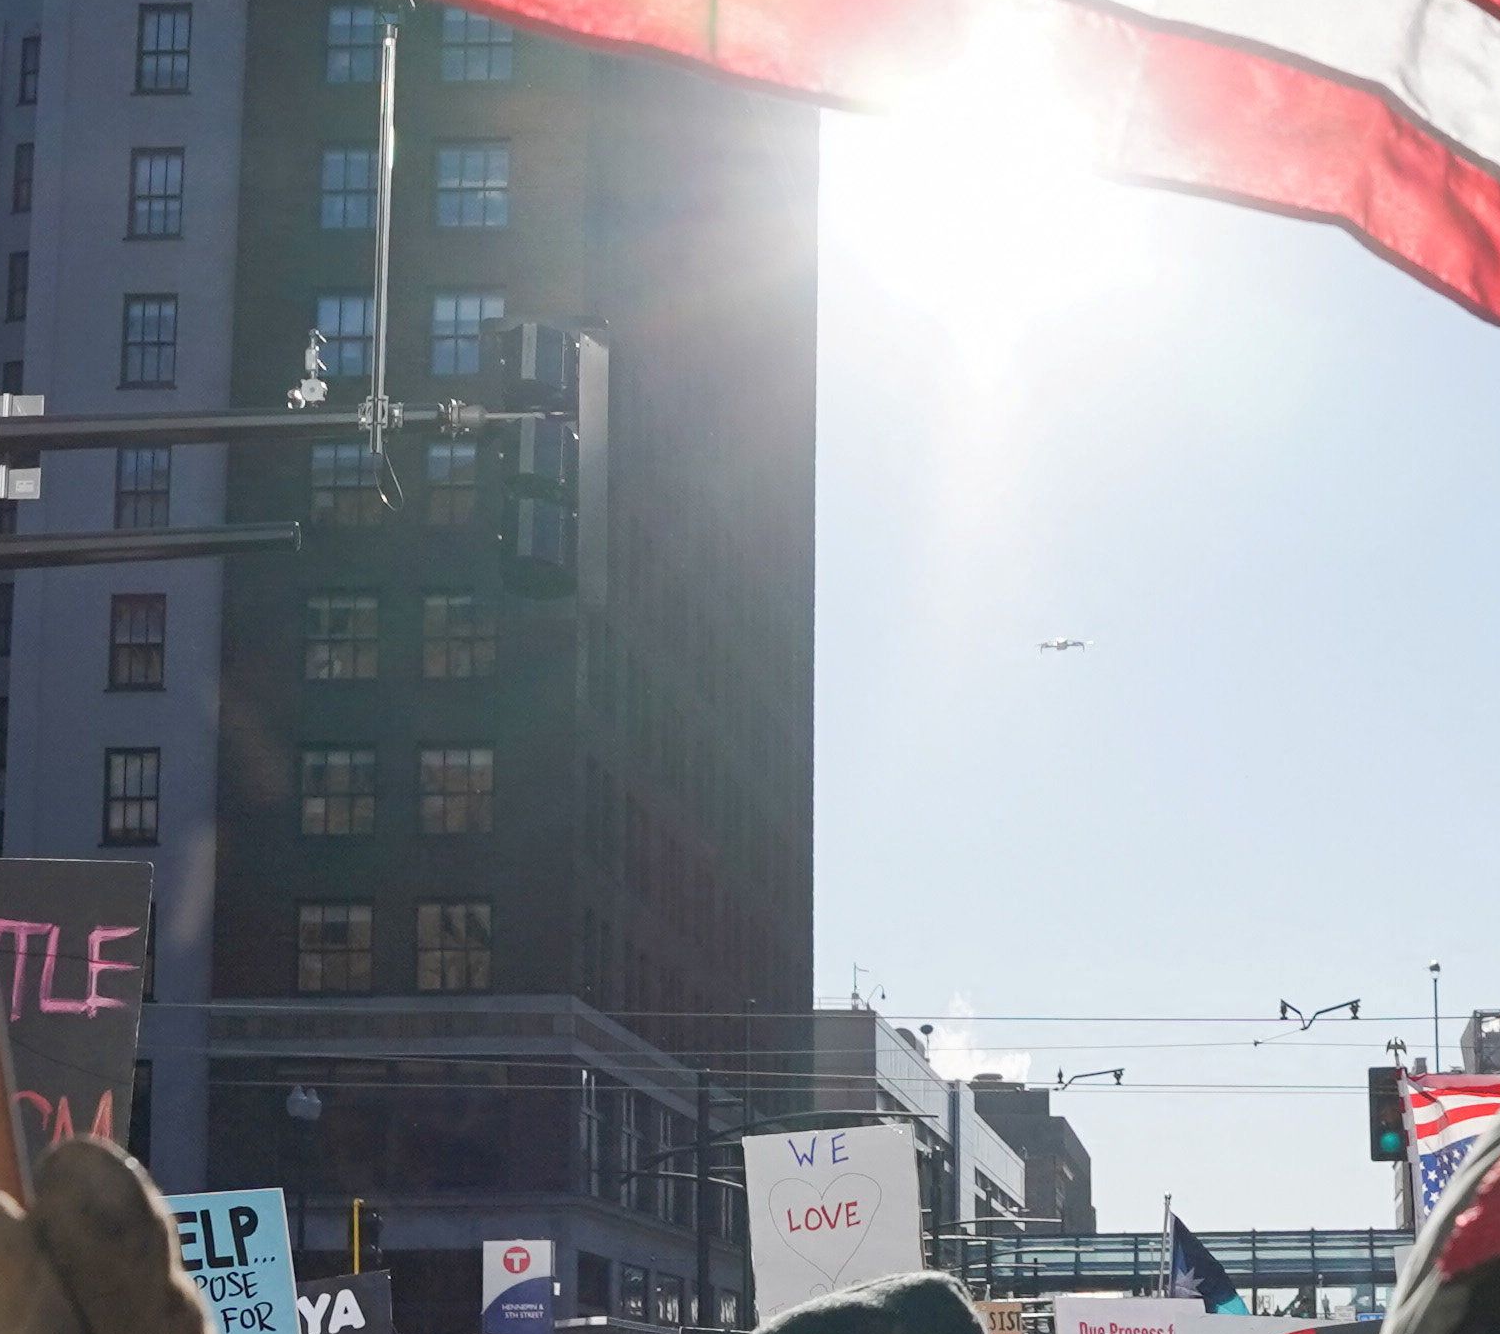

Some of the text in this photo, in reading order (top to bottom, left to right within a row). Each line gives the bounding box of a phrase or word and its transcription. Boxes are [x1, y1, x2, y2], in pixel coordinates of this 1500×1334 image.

[787, 1133, 849, 1167] WE
[787, 1201, 861, 1233] LOVE
[171, 1206, 276, 1272] ELP...
[193, 1271, 258, 1302] POSE
[221, 1301, 277, 1334] FOR
